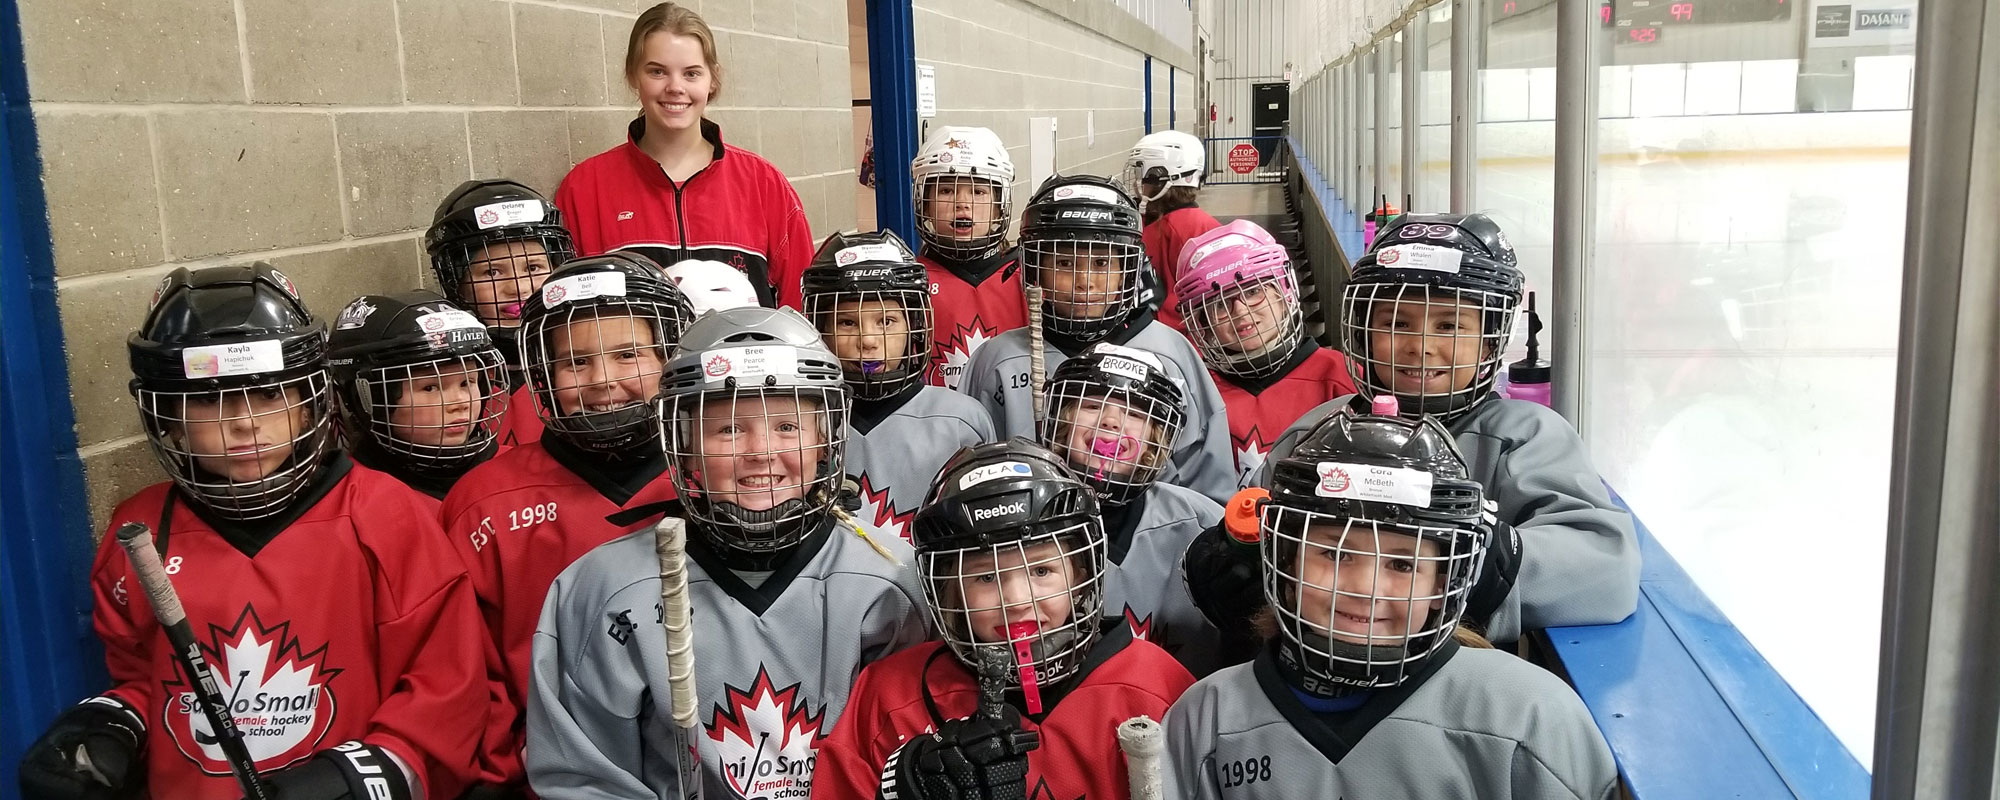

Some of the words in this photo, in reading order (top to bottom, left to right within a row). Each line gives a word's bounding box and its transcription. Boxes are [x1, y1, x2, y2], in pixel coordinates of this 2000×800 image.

[1861, 13, 1904, 26] DASANI
[501, 202, 525, 210] Delaney
[1399, 223, 1455, 240] 89
[577, 274, 596, 283] Katie
[227, 345, 251, 354] Kayla
[744, 347, 764, 355] Bree
[224, 355, 255, 364] Hapichuk
[1102, 356, 1146, 377] BROOKE
[968, 464, 1012, 483] LYLA
[1370, 467, 1393, 476] Cora
[1364, 477, 1395, 488] McBeth
[508, 501, 558, 532] 1998
[974, 501, 1026, 522] Reebok
[1007, 659, 1064, 684] Rebok
[251, 686, 321, 714] Small
[270, 713, 312, 727] hockey
[248, 725, 286, 738] school
[1221, 754, 1272, 789] 1998
[752, 776, 793, 794] female
[773, 787, 811, 800] school
